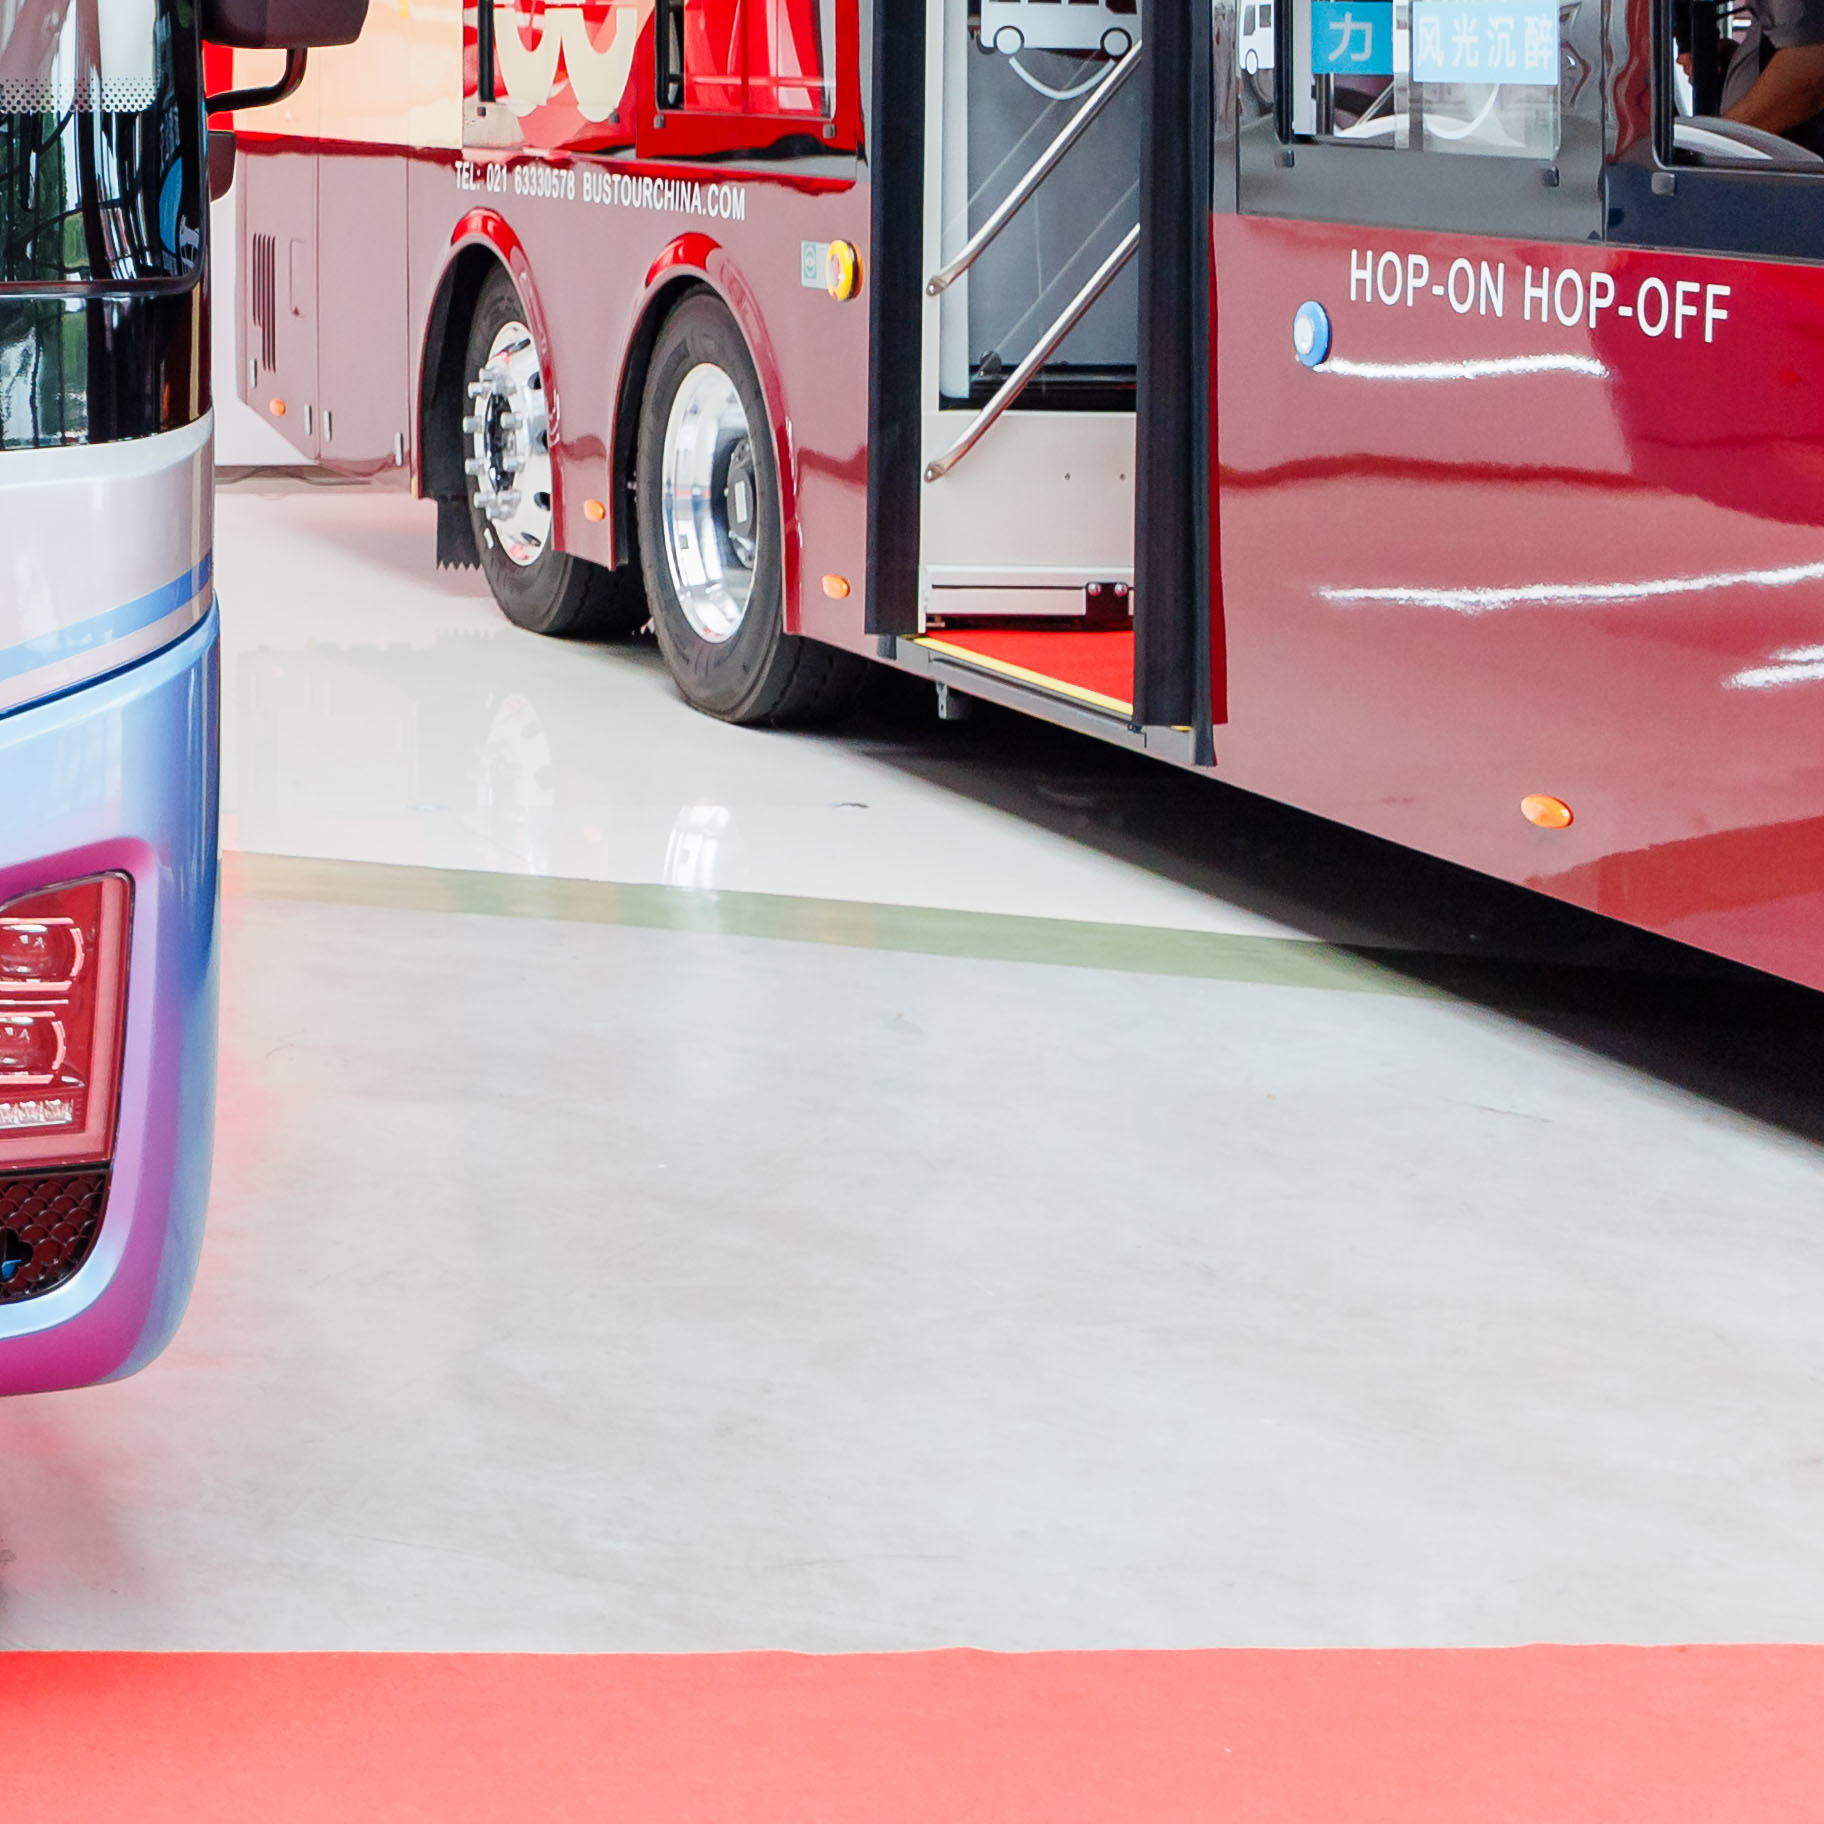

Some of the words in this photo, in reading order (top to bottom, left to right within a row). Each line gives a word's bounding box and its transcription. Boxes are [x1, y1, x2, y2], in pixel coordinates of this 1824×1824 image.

[1417, 14, 1554, 69] 风光沉醉
[455, 161, 480, 191] TEL:
[486, 163, 507, 192] 021
[514, 165, 575, 200] 63330578
[583, 171, 745, 221] BUSTOURCHINA.COM
[1350, 248, 1505, 318] HOP-ON
[1524, 264, 1731, 344] HOP-OFF
